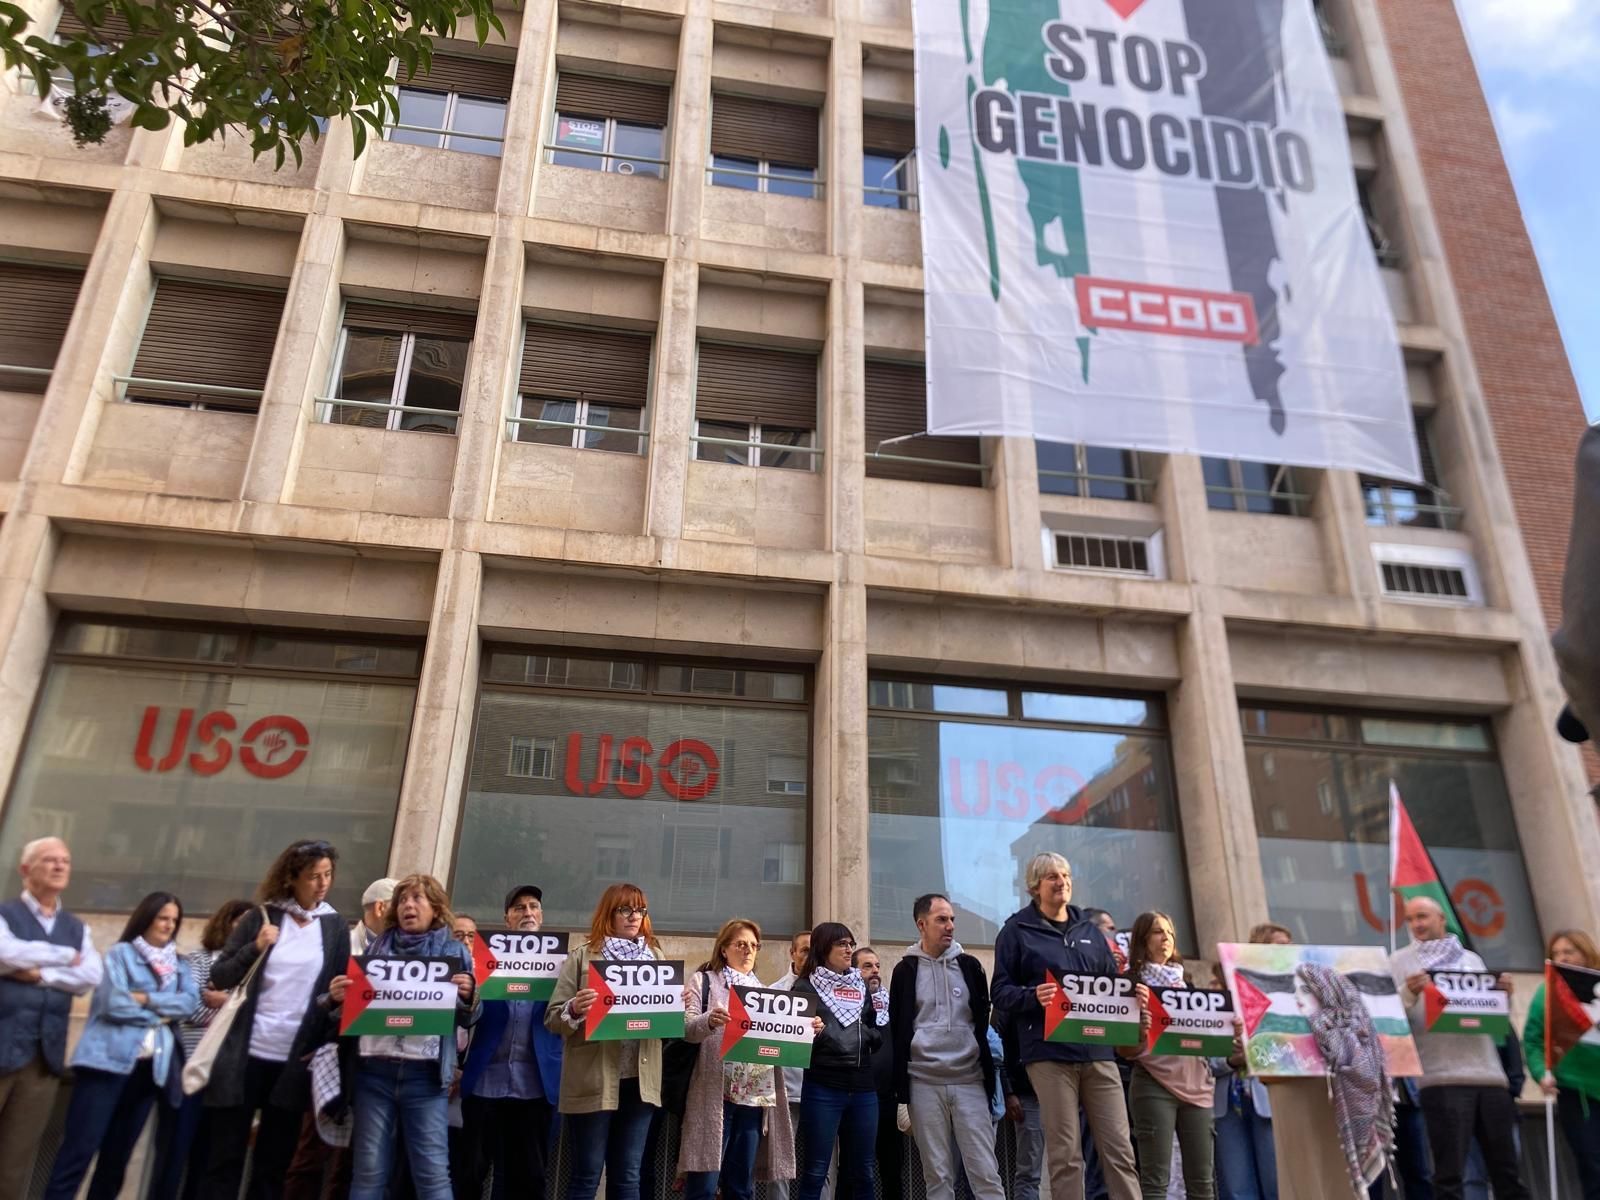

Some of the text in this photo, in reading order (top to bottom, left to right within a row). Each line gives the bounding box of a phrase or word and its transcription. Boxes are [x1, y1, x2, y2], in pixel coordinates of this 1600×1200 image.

[1045, 23, 1205, 97] STOP
[568, 120, 600, 131] STOP
[973, 89, 1316, 194] GENOCIDIO
[1088, 286, 1248, 334] CCOO
[133, 706, 310, 779] USO
[564, 732, 721, 801] USO
[947, 756, 1090, 825] USO
[488, 933, 560, 955] STOP
[365, 958, 449, 983] STOP
[486, 959, 556, 972] GENOCIDIO
[604, 964, 676, 986] STOP
[507, 984, 530, 992] CCOO
[1062, 973, 1132, 998] STOP
[1433, 972, 1497, 992] STOP
[362, 989, 444, 1002] GENOCIDIO
[603, 993, 675, 1006] GENOCIDIO
[743, 991, 809, 1017] STOP
[1161, 989, 1226, 1013] STOP
[1060, 1001, 1130, 1016] GENOCIDIO
[627, 1020, 651, 1029] CCOO
[740, 1019, 806, 1036] GENOCIDIO
[1160, 1016, 1225, 1030] GENOCIDIO
[759, 1046, 780, 1056] CCOO
